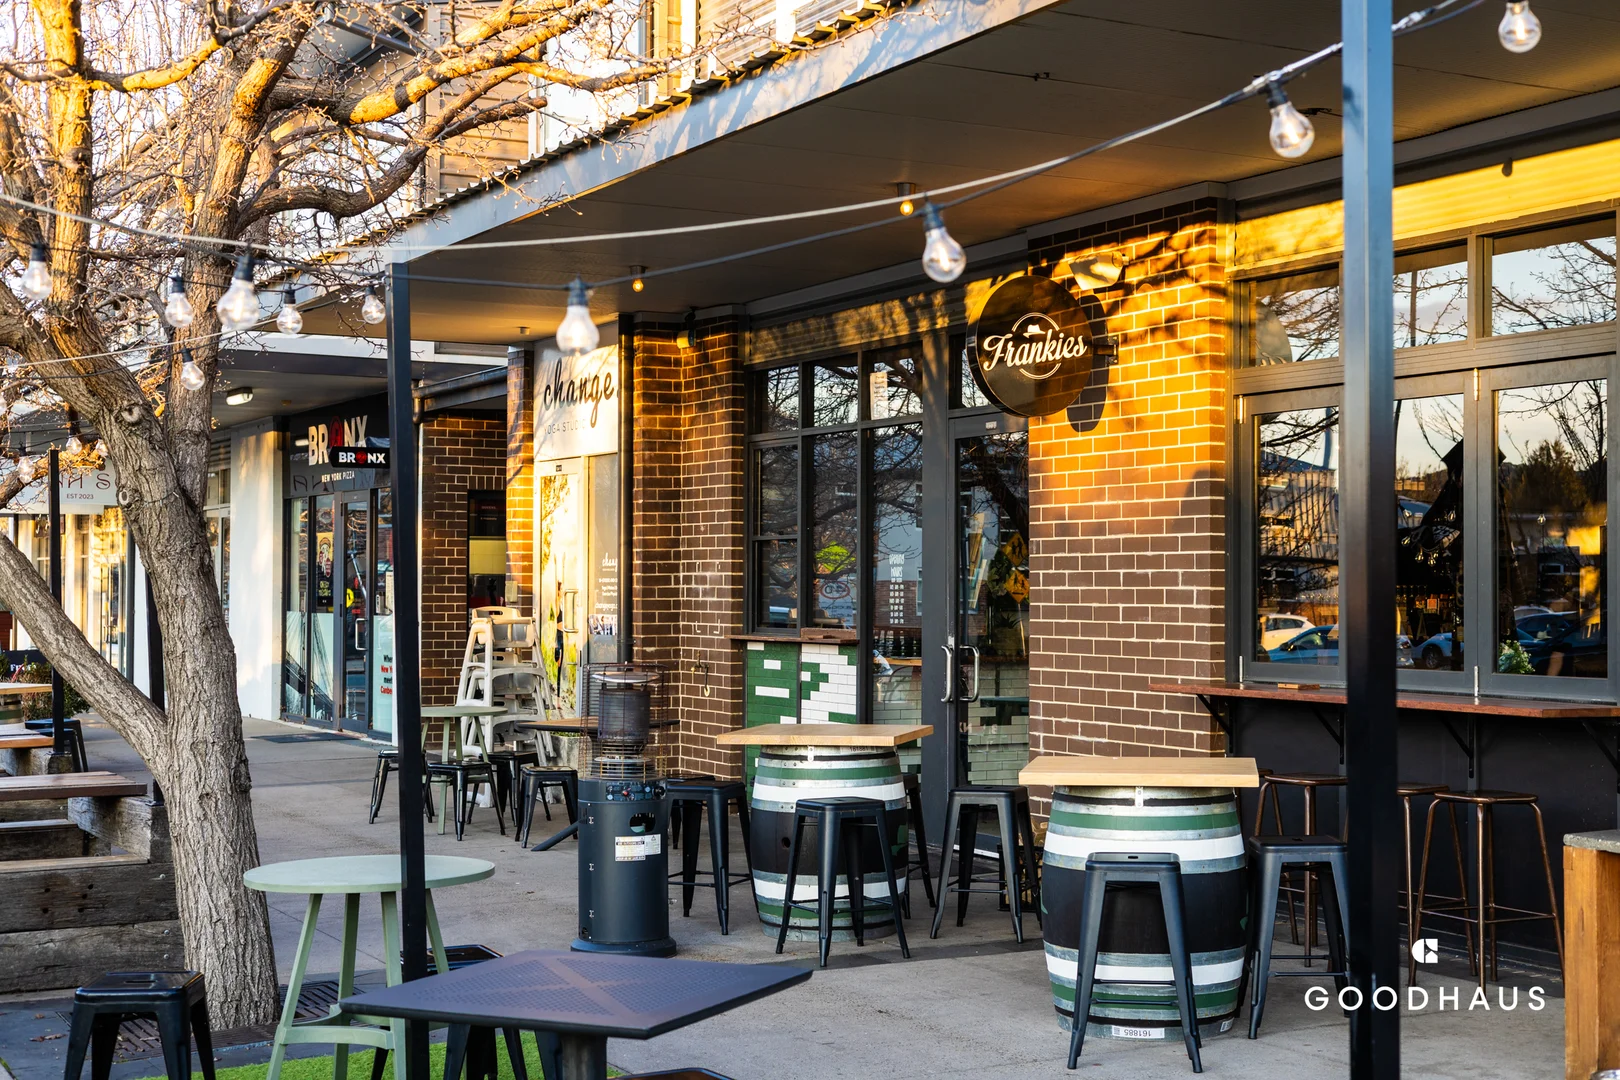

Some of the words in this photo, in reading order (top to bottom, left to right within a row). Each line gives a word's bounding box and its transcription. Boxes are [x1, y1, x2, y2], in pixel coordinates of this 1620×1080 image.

[983, 328, 1088, 371] Frankies
[543, 357, 614, 428] change
[338, 451, 386, 464] BRONX
[321, 474, 331, 483] NEW
[331, 472, 342, 481] YORK
[342, 470, 355, 480] PIZZA
[1124, 1028, 1152, 1037] 161885
